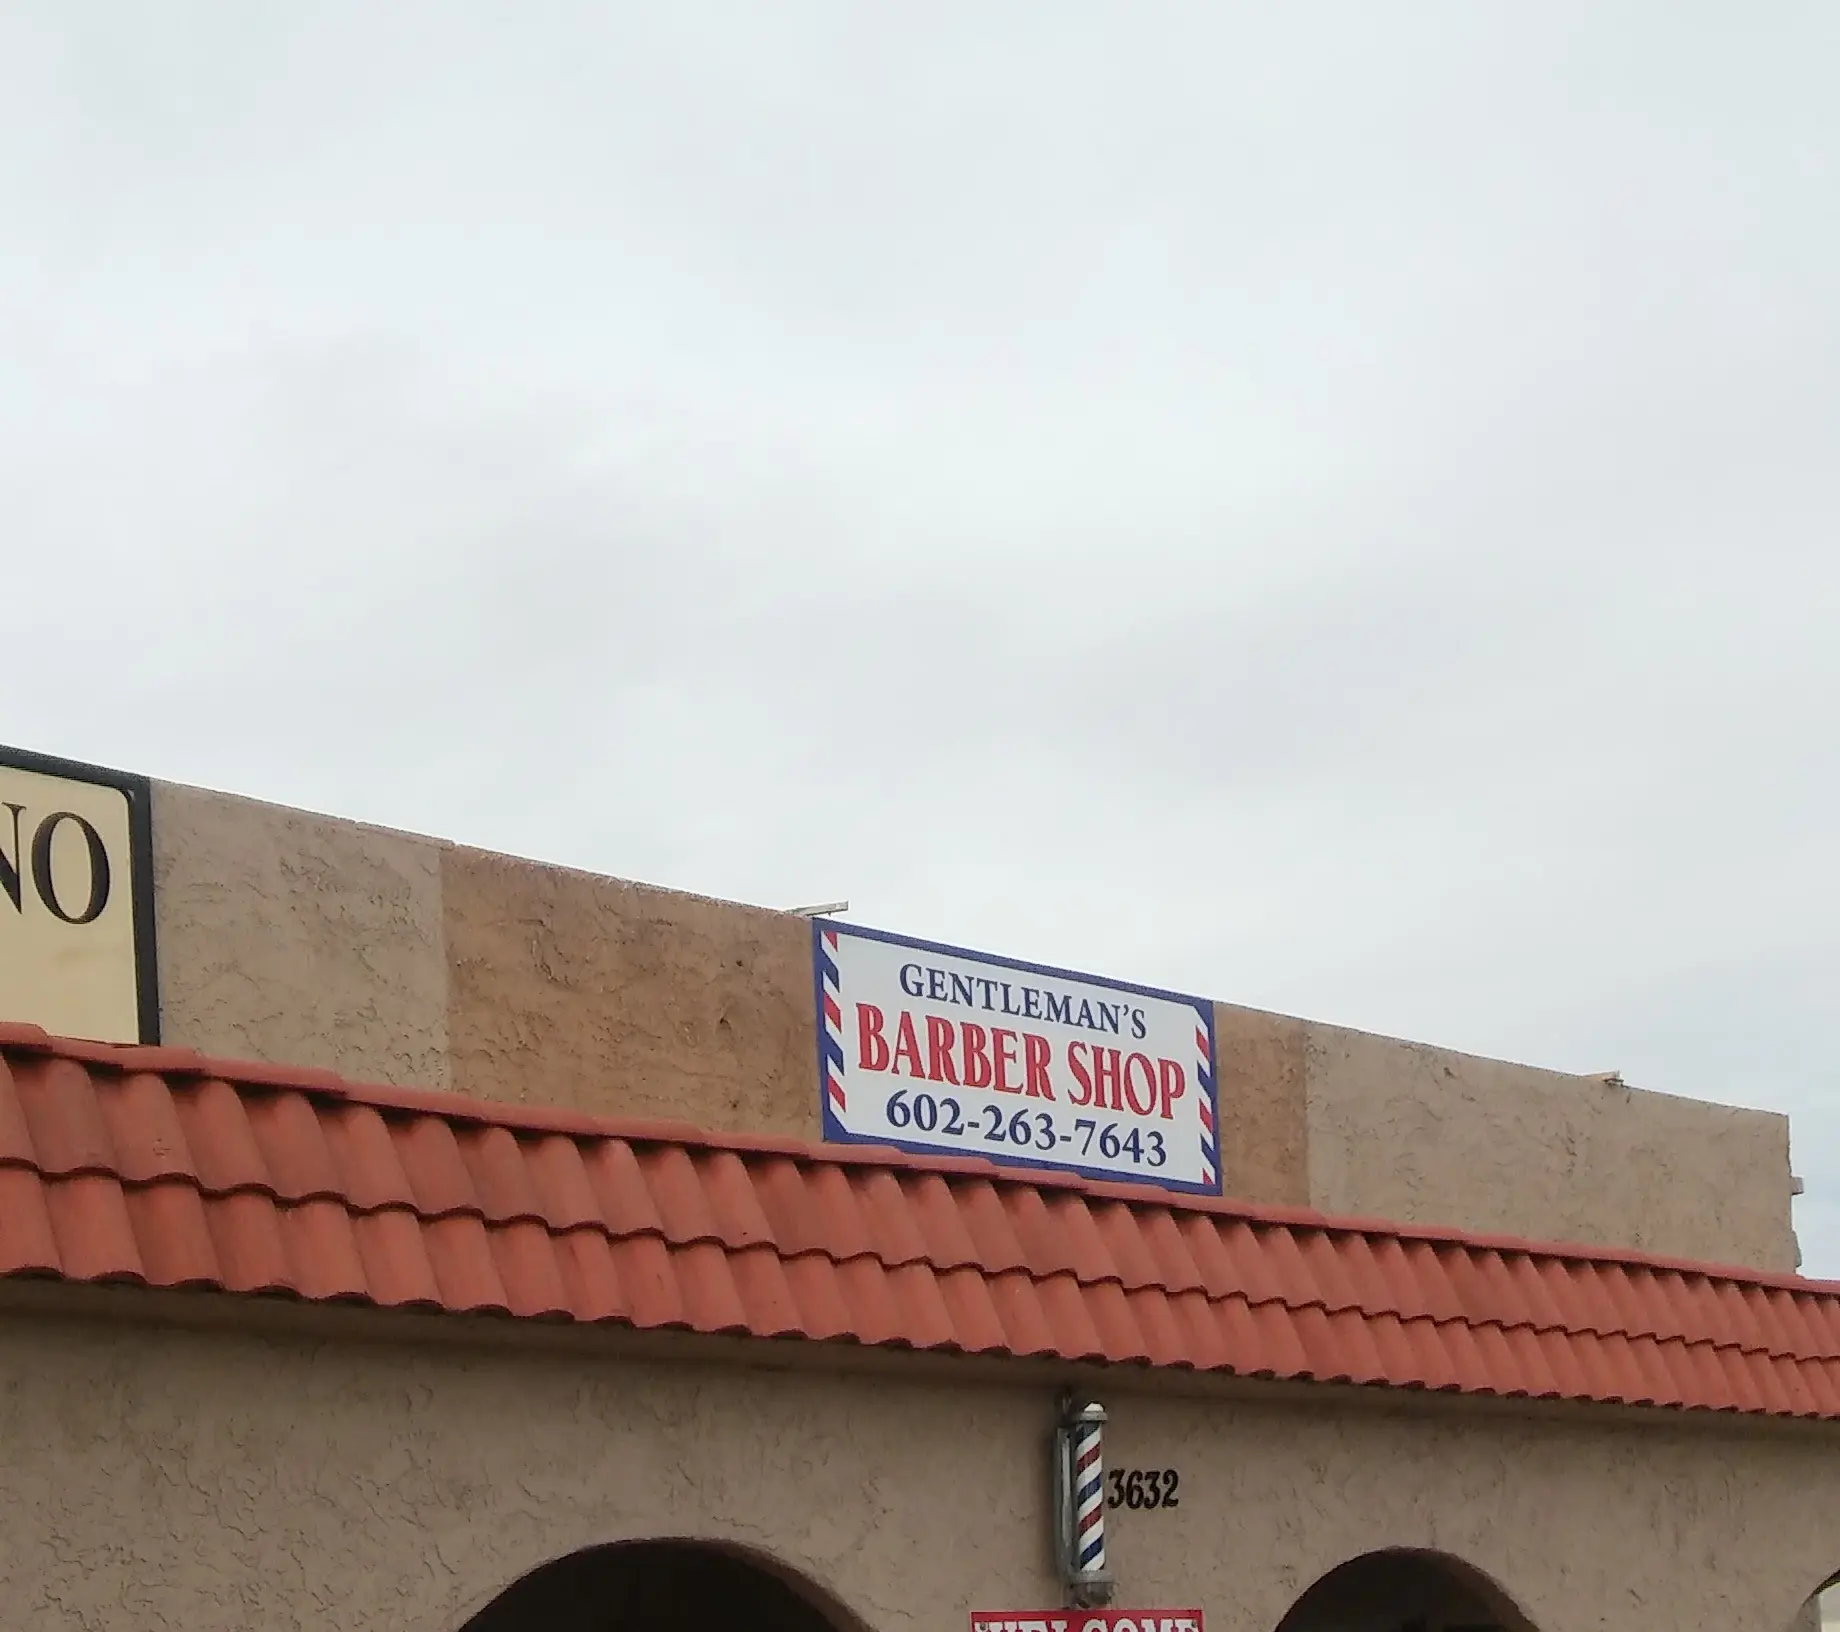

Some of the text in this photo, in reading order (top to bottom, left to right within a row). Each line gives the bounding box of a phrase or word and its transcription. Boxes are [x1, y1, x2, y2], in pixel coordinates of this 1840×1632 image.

[900, 963, 1146, 1039] GENTLEMAN'S
[856, 1002, 1186, 1120] BARBER SHOP
[886, 1089, 1167, 1167] 602-263-7643
[1107, 1468, 1180, 1509] 3632
